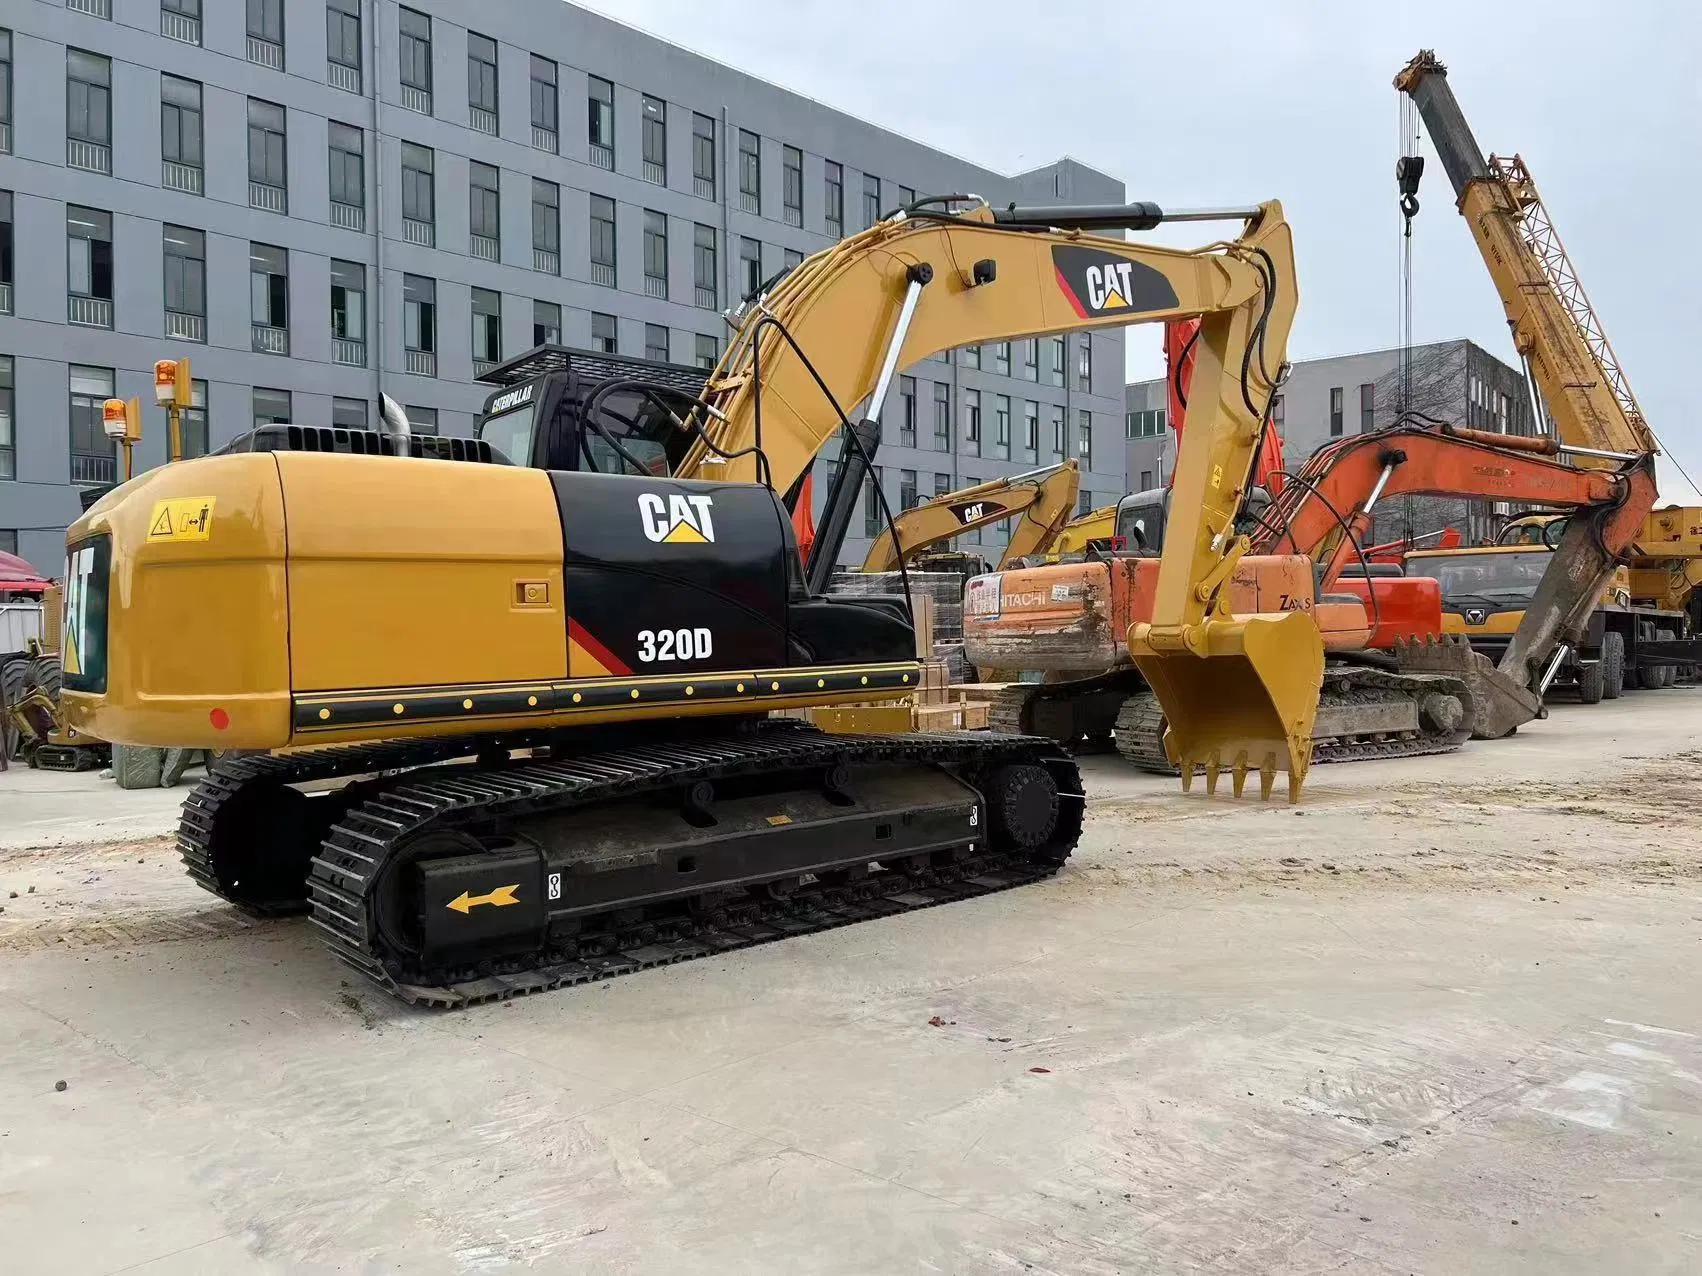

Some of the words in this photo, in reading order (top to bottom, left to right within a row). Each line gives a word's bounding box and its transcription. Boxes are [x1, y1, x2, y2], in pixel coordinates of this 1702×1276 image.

[1086, 262, 1133, 310] CAT
[491, 384, 534, 413] CATERPILLAR
[637, 493, 715, 543] CAT
[964, 502, 984, 522] CAT
[1279, 594, 1311, 611] ZAXS
[637, 627, 713, 663] 320D
